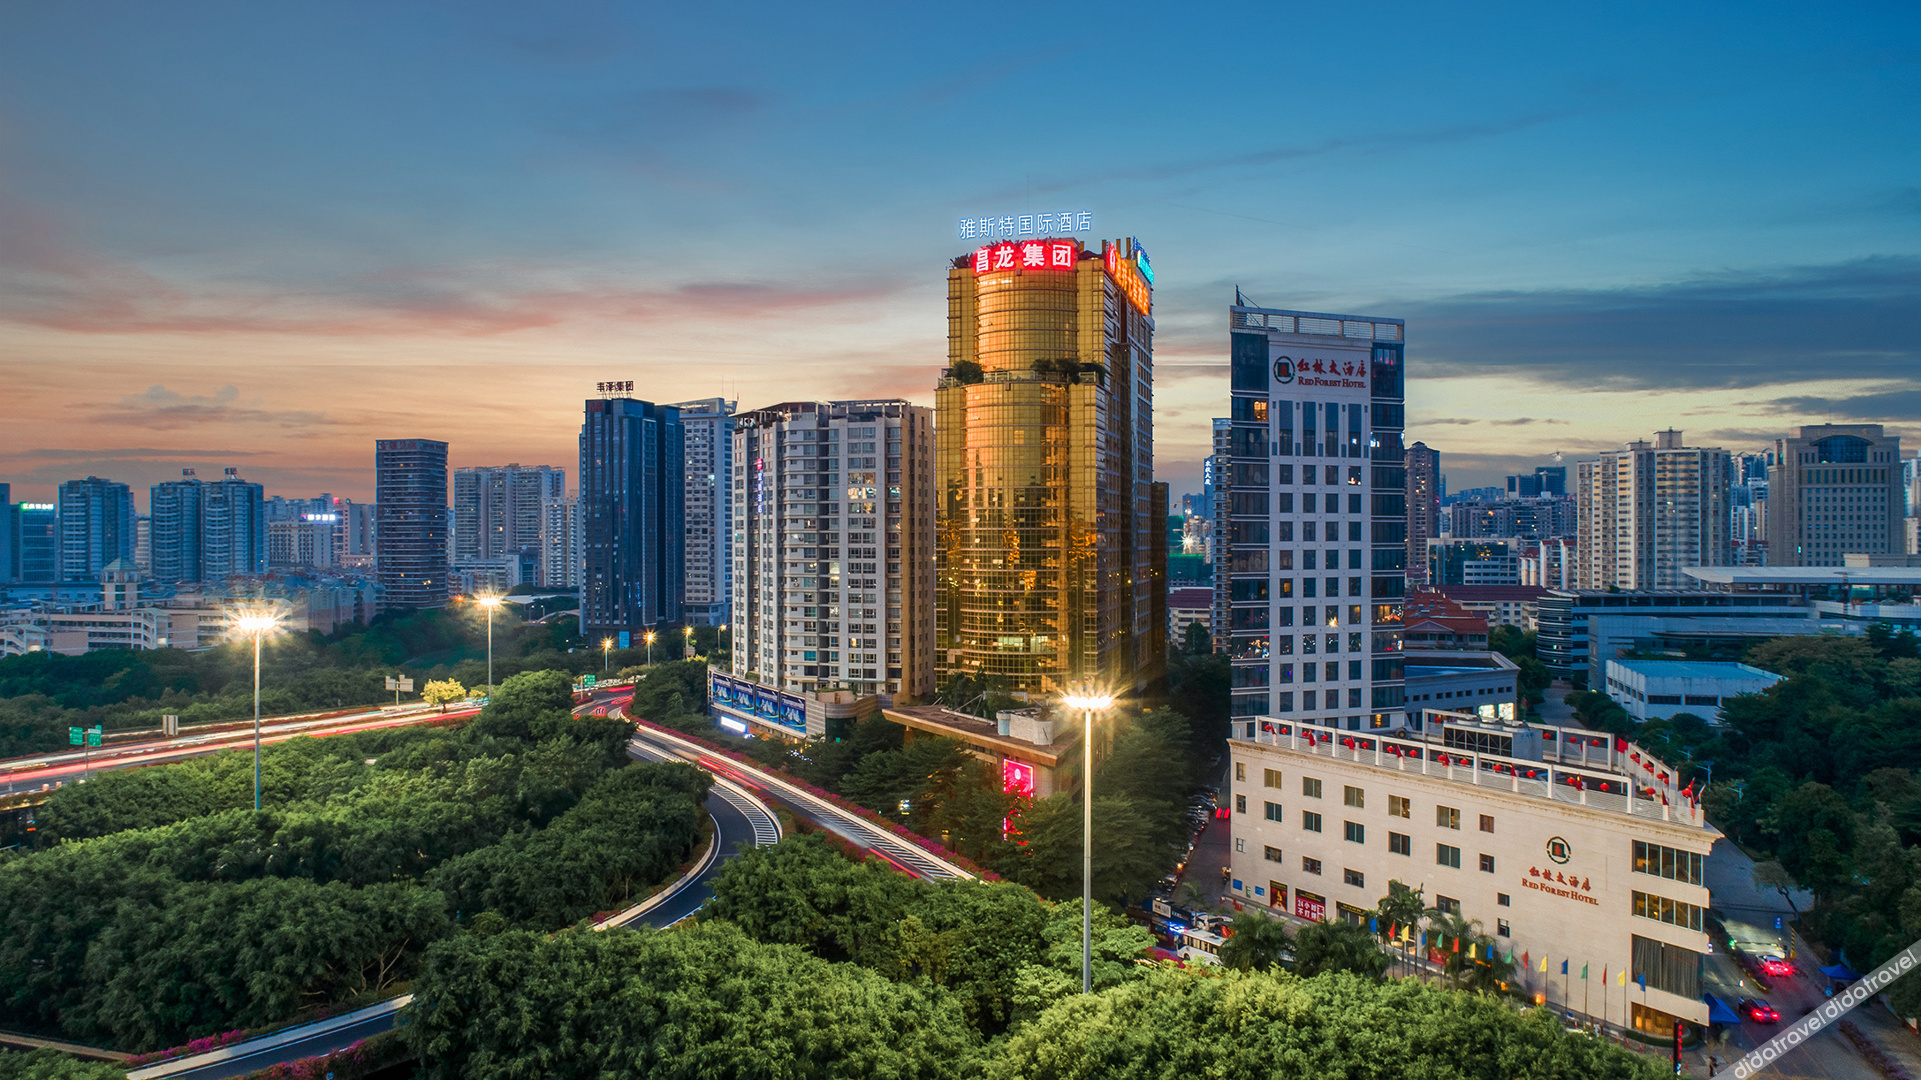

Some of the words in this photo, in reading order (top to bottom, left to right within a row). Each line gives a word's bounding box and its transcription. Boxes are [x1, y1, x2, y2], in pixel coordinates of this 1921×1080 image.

[959, 210, 1093, 240] 雅斯特国际酒店
[975, 242, 1073, 273] 昌龙集团
[1296, 358, 1367, 378] 红林大酒店
[1297, 376, 1315, 387] RED
[1314, 377, 1342, 388] FOREST
[1342, 378, 1367, 389] HOTEL
[1521, 877, 1539, 890] RED
[1540, 882, 1570, 898] FOREST
[1570, 890, 1599, 905] HOTEL
